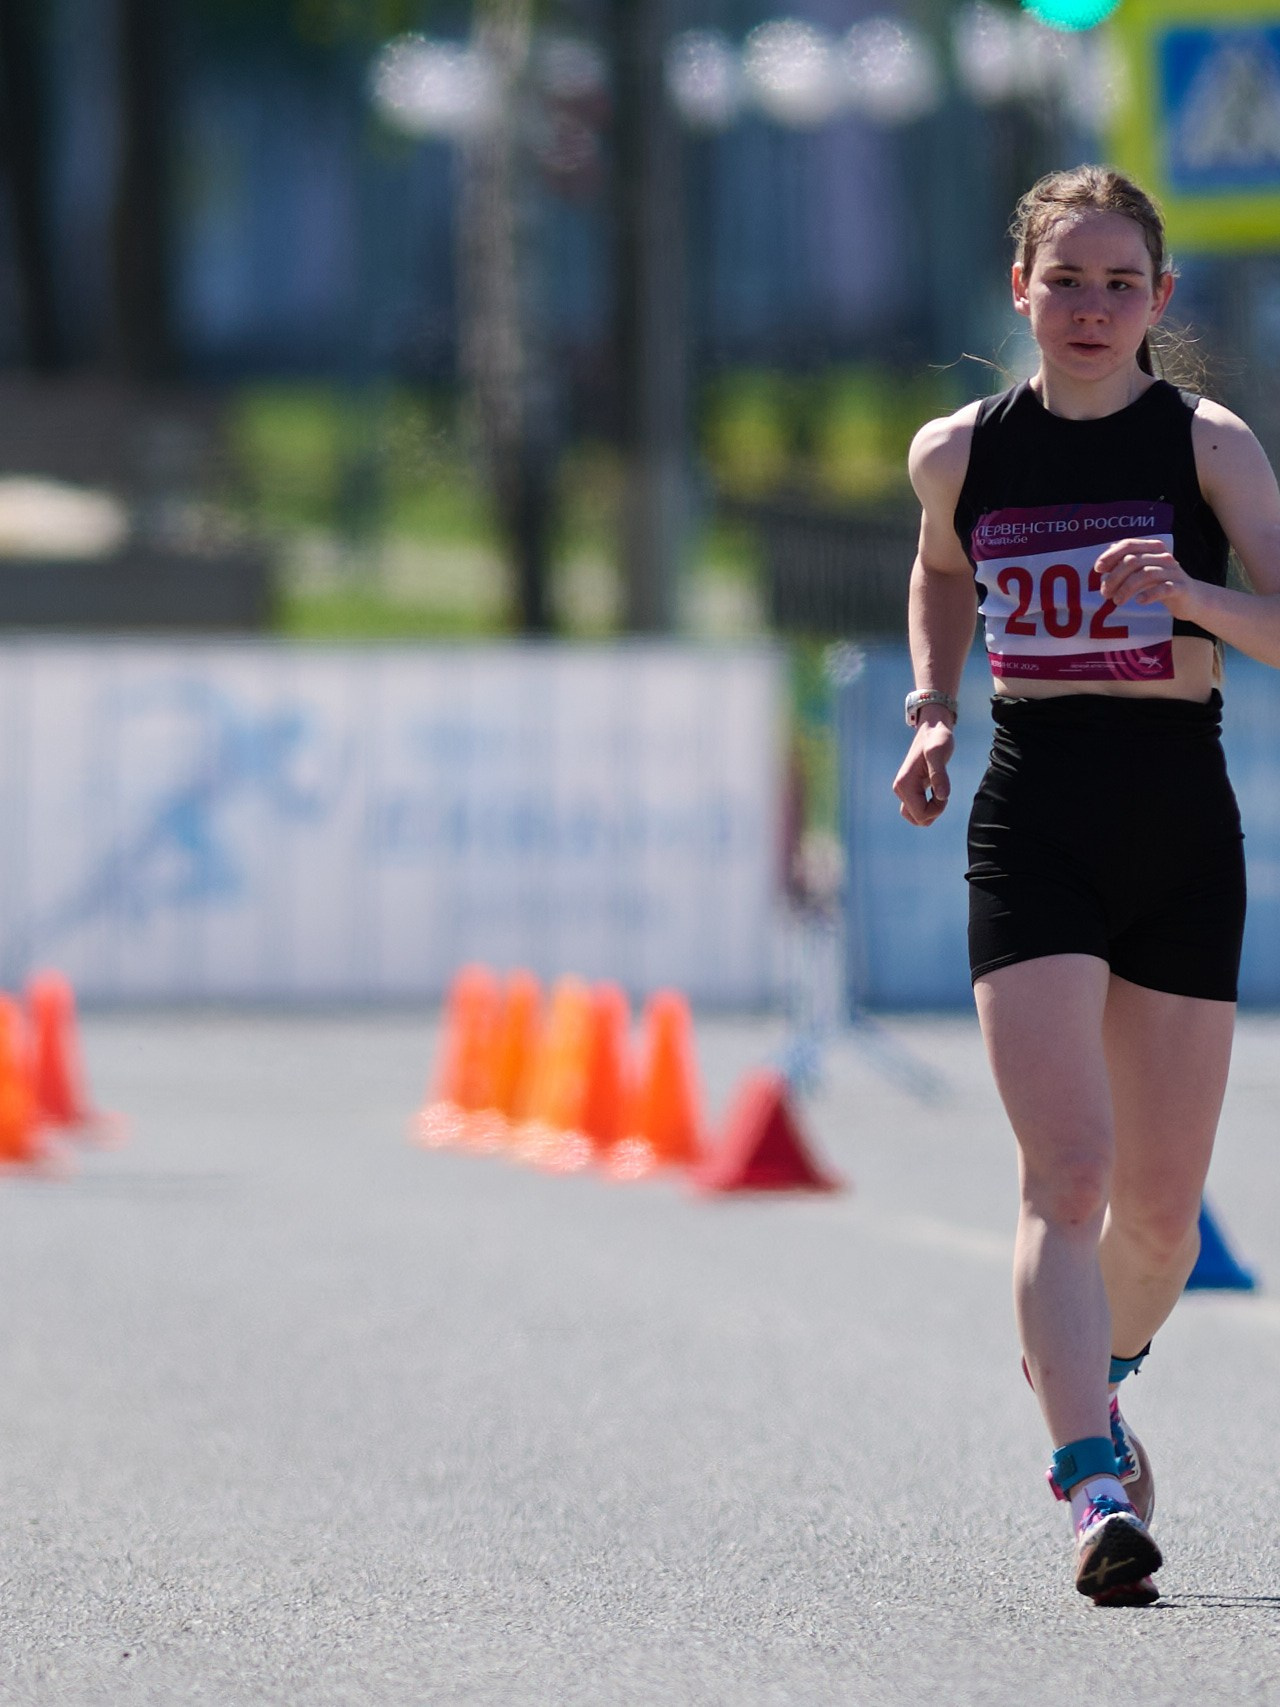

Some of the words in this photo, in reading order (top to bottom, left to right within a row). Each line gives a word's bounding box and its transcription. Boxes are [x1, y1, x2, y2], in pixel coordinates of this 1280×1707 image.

[975, 519, 1079, 536] ПЕРВЕНСТВО
[1083, 515, 1155, 530] РОССИИ
[997, 564, 1129, 639] 202
